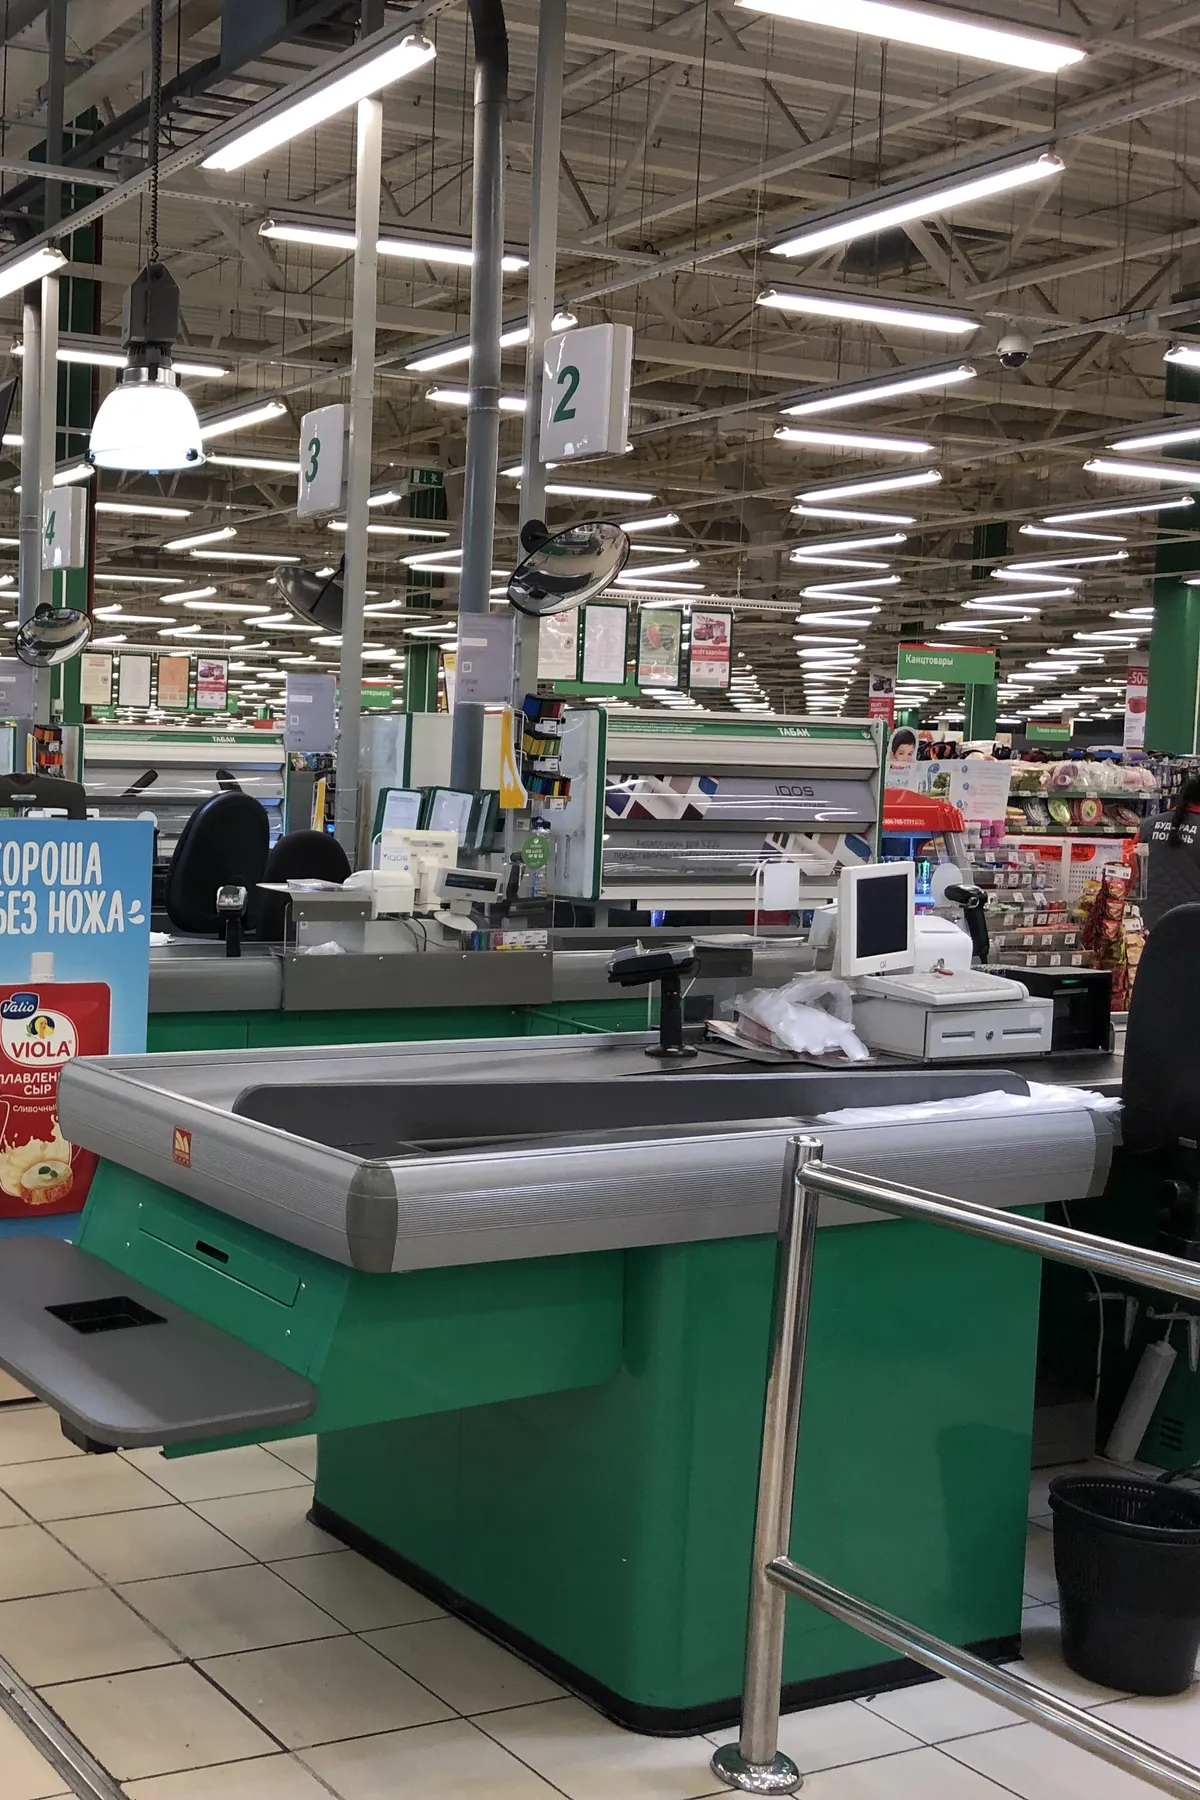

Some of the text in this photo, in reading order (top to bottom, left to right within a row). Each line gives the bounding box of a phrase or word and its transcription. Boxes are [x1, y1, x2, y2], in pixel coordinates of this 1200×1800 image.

[553, 365, 580, 423] 2
[305, 437, 321, 483] 3
[45, 510, 56, 545] 4
[905, 653, 954, 666] Канцтовары
[777, 727, 811, 737] ТАБАК
[775, 785, 814, 797] IQOS
[1154, 821, 1172, 831] БУД
[48, 889, 125, 934] НОЖА
[2, 1000, 35, 1013] Valio
[11, 1041, 71, 1058] VIOLA
[24, 1084, 52, 1095] СЫР
